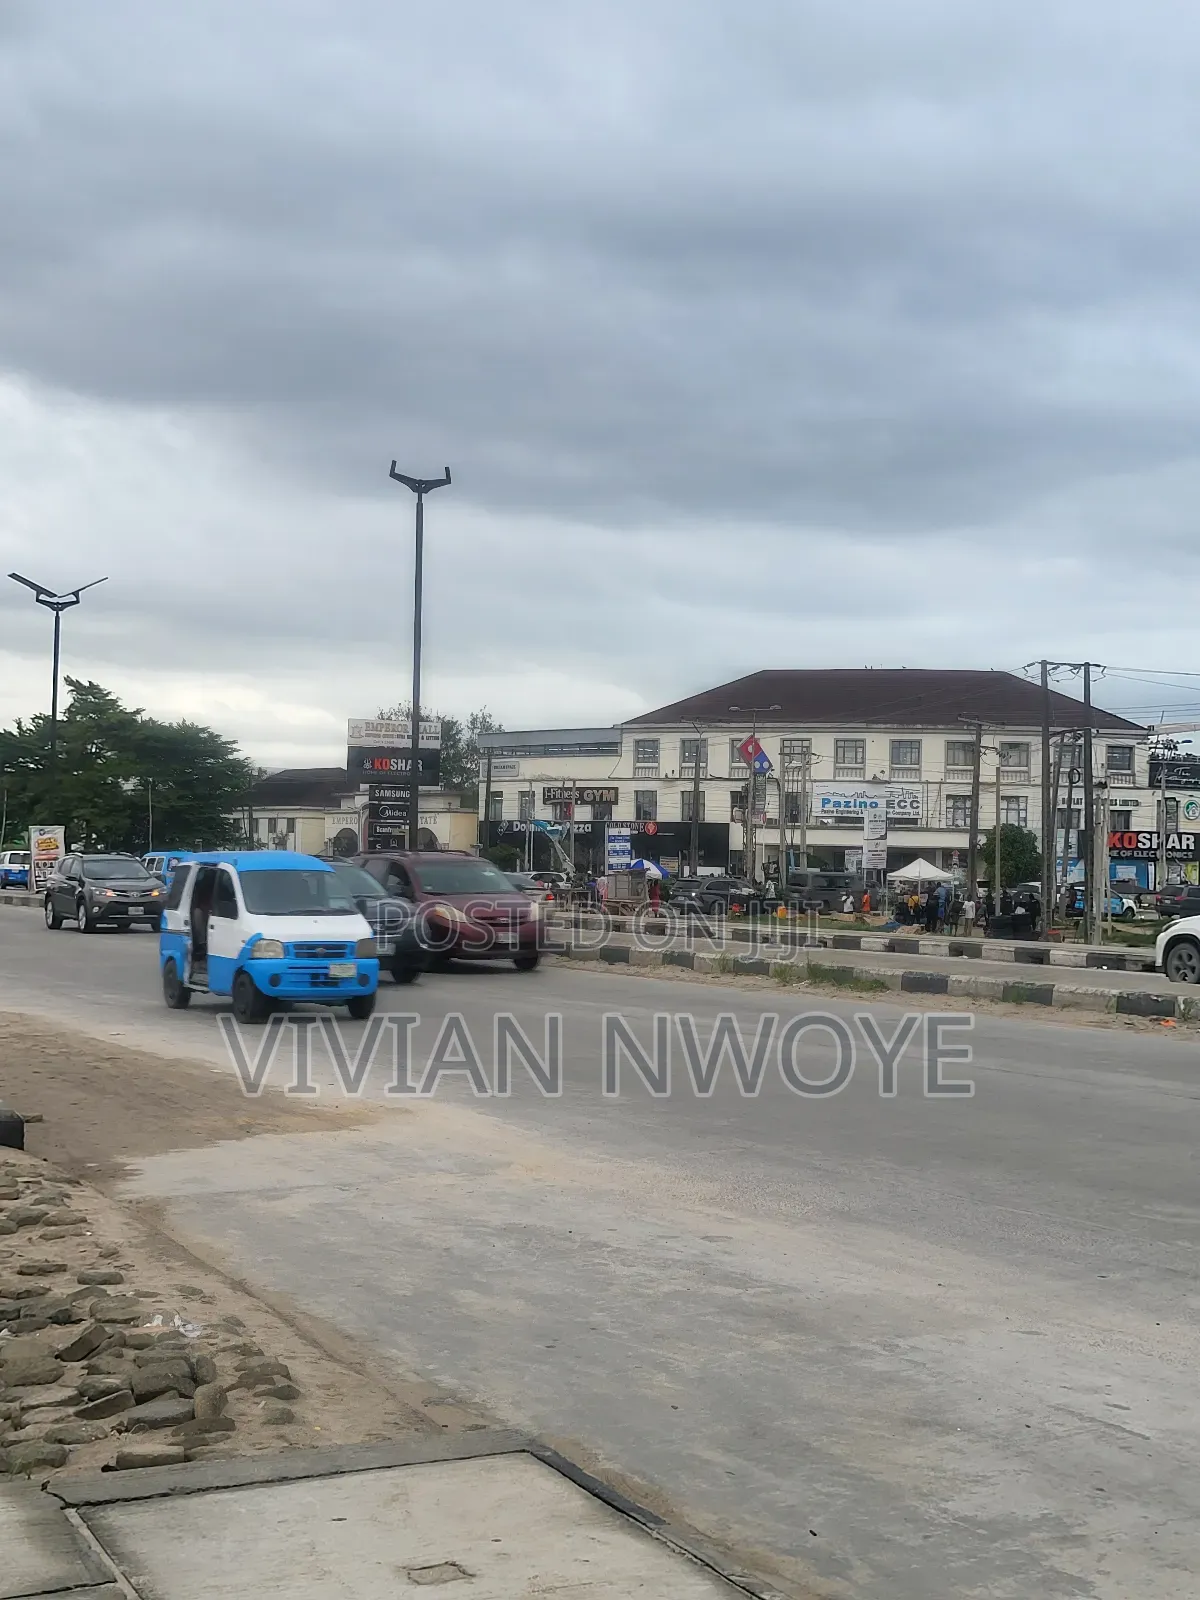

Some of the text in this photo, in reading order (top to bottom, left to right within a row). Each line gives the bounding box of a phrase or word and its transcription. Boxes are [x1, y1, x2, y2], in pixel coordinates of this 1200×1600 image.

[364, 721, 440, 735] EMPEROR ALL
[374, 790, 410, 798] SAMSUNG
[584, 790, 616, 802] GYM
[821, 797, 920, 810] Pazino ECC
[378, 806, 407, 817] Midea
[332, 816, 358, 824] EMPERO
[623, 822, 645, 832] STONE
[1107, 832, 1195, 850] KOSHAR
